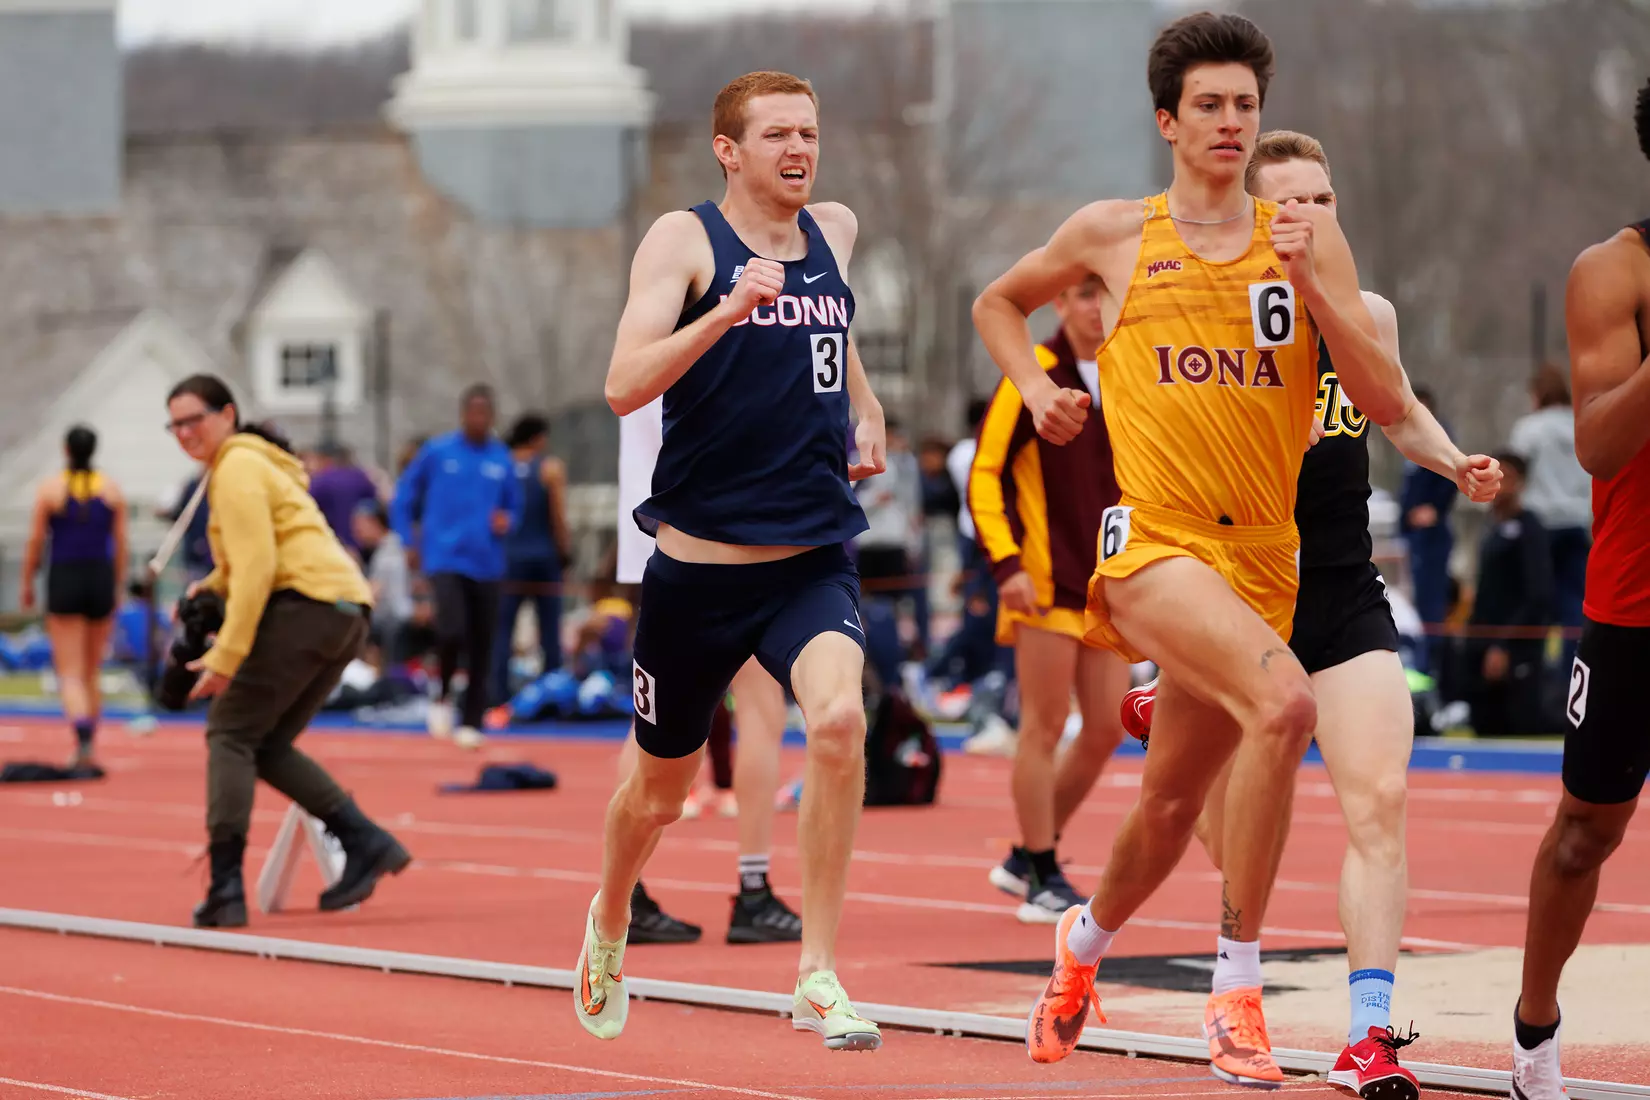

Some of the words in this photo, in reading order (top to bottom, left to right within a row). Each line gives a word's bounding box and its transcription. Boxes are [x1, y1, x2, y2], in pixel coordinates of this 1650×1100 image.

[1147, 259, 1182, 278] MAAC
[1258, 285, 1291, 342] 6
[816, 336, 838, 389] 3
[1153, 345, 1285, 388] IONA
[1103, 509, 1123, 560] 6
[634, 667, 650, 716] 3
[1569, 663, 1585, 723] 2
